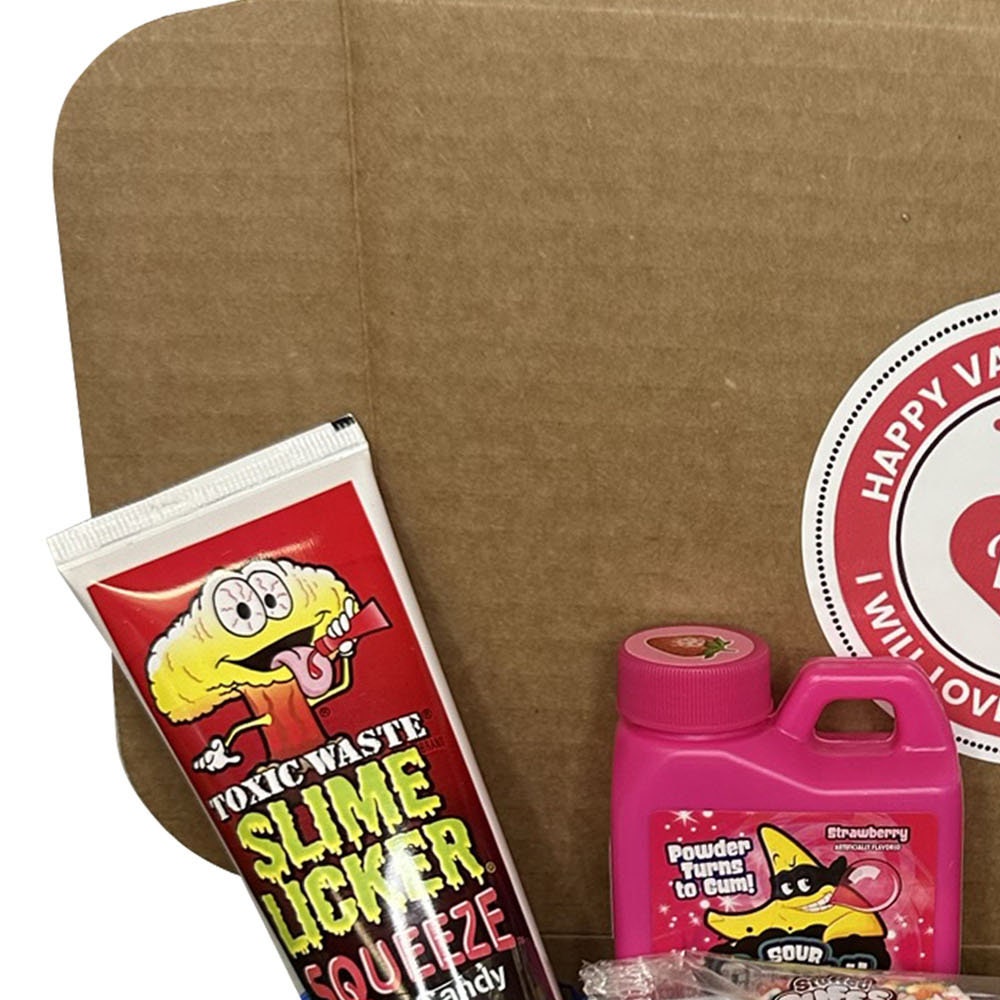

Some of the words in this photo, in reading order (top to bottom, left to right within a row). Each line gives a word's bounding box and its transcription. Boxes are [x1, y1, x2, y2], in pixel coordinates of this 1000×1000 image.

[861, 377, 949, 503] HAPPY
[855, 572, 883, 584] I
[209, 761, 304, 821] TOXIC
[303, 713, 428, 775] WASTE
[237, 747, 441, 886] SLIME
[827, 826, 909, 842] Strawberry
[667, 838, 752, 863] Powder
[680, 858, 744, 880] Turns
[262, 818, 486, 957] LICKER
[675, 880, 698, 899] to
[767, 944, 824, 965] SOUR
